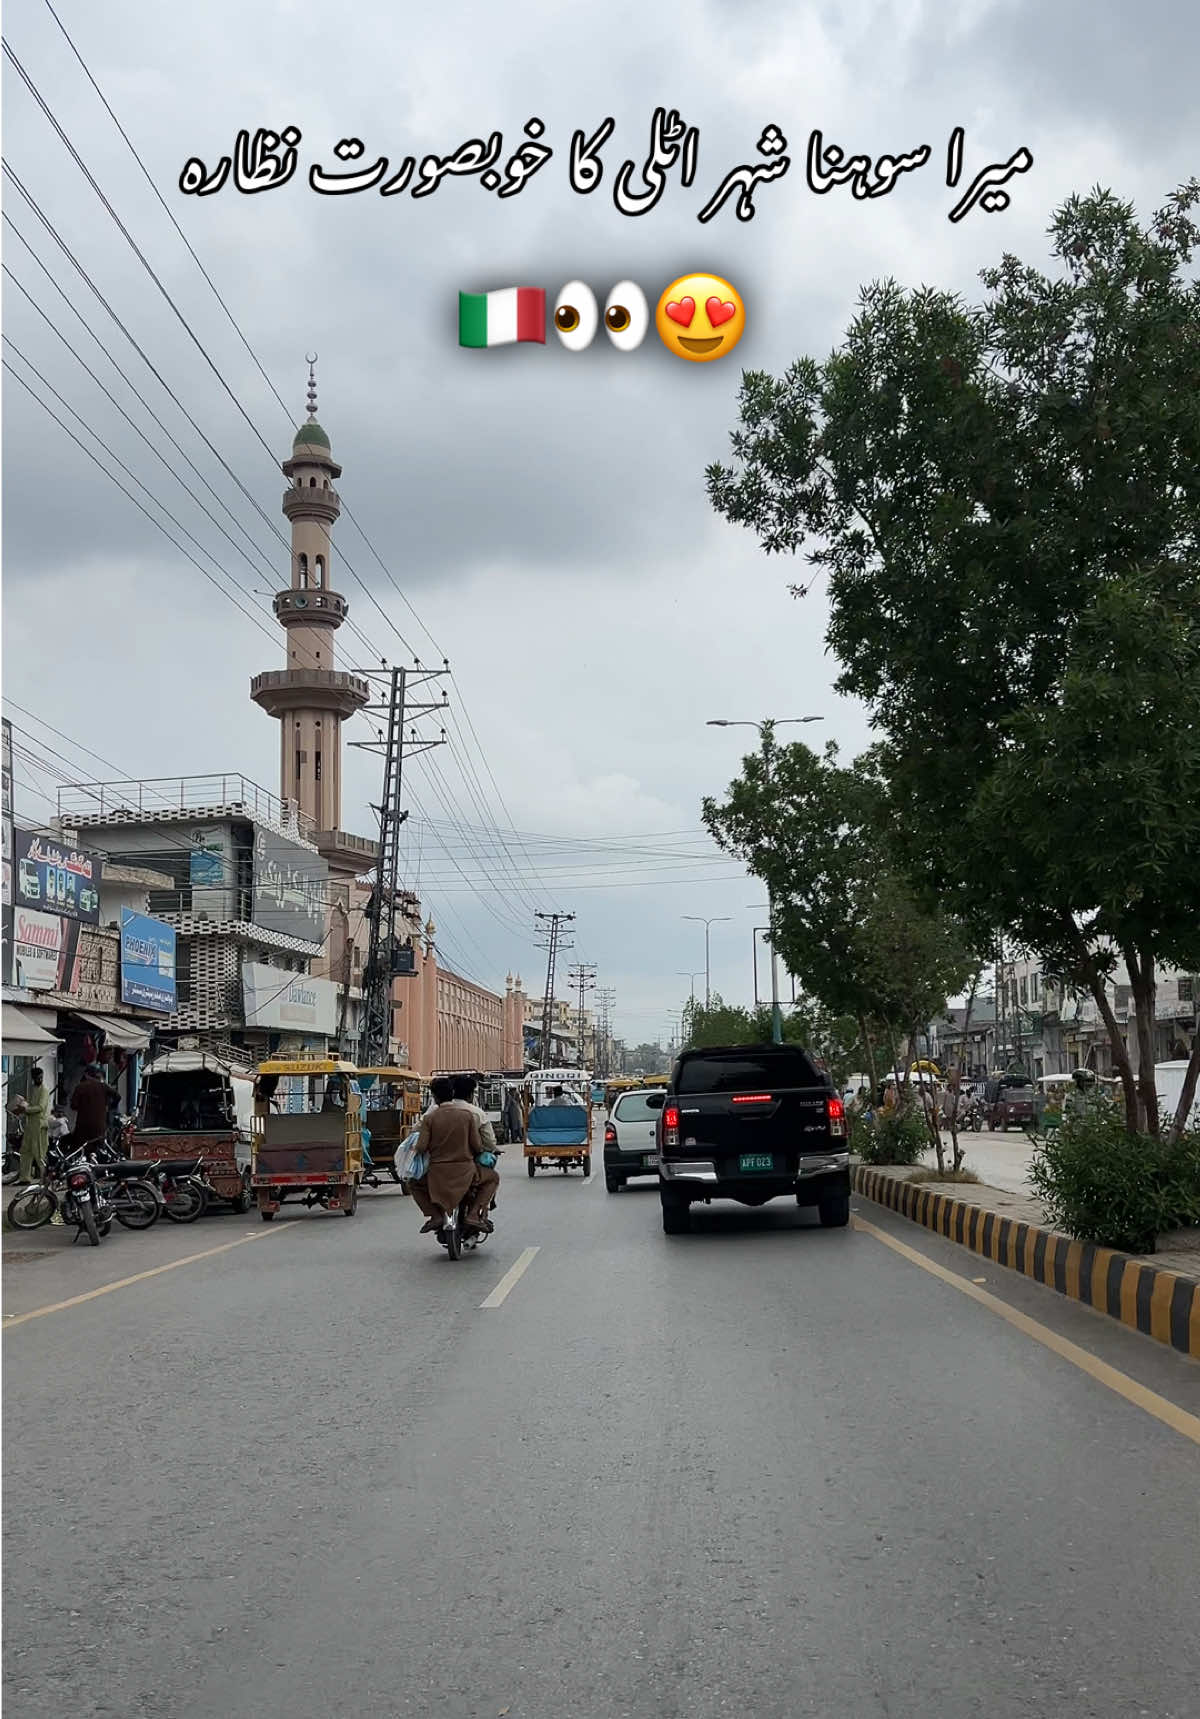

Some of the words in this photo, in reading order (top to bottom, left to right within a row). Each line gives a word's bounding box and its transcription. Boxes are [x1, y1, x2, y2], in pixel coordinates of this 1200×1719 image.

[18, 915, 59, 947] Sammi
[125, 935, 157, 959] PHOENIX
[283, 1062, 327, 1072] SUZUKI
